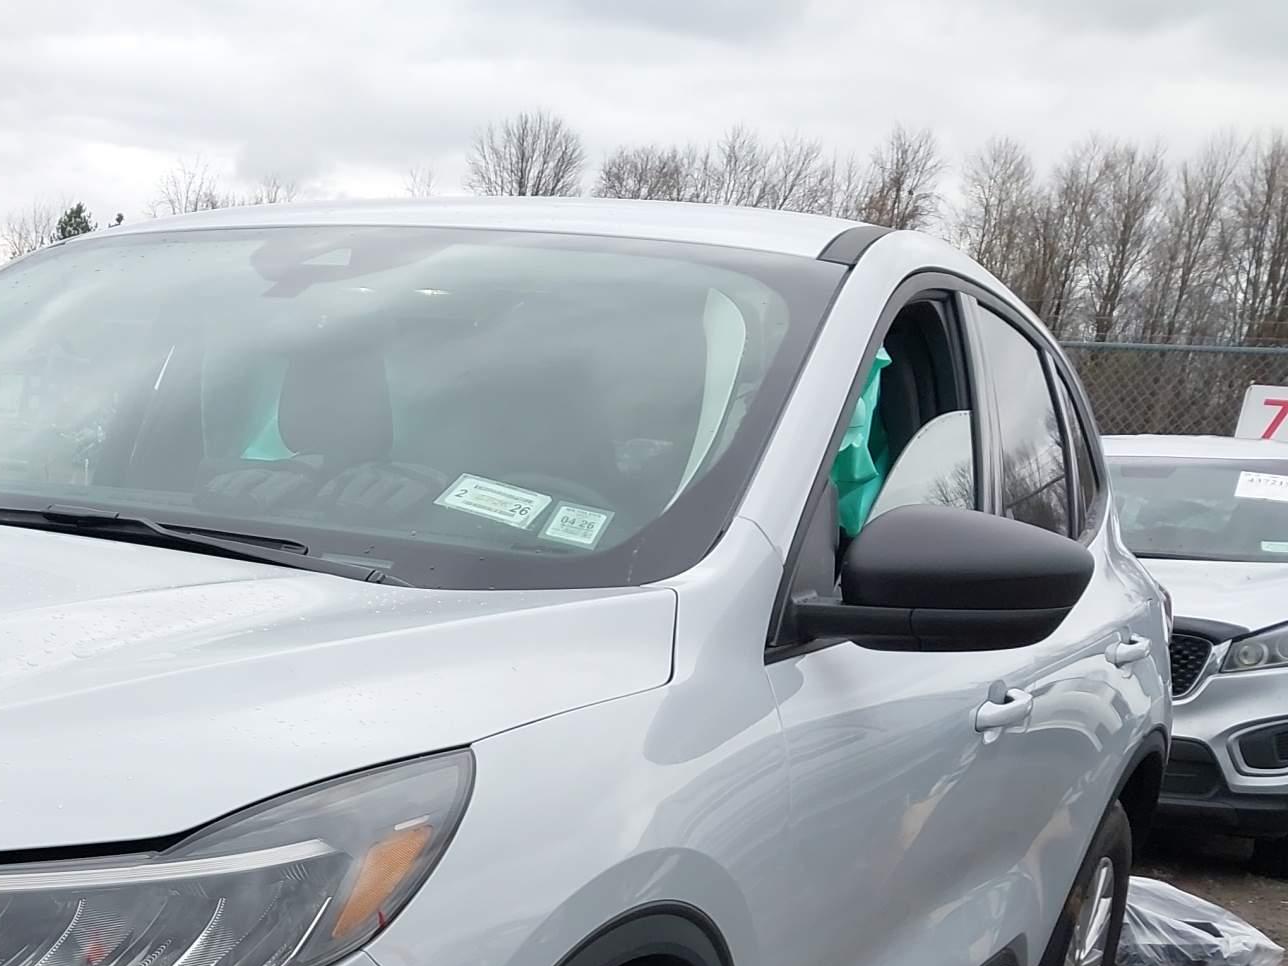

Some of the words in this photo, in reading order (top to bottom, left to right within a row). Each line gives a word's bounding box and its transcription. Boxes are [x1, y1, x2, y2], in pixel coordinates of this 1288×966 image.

[1263, 398, 1288, 440] 7
[454, 488, 469, 498] 2
[509, 502, 531, 516] 26
